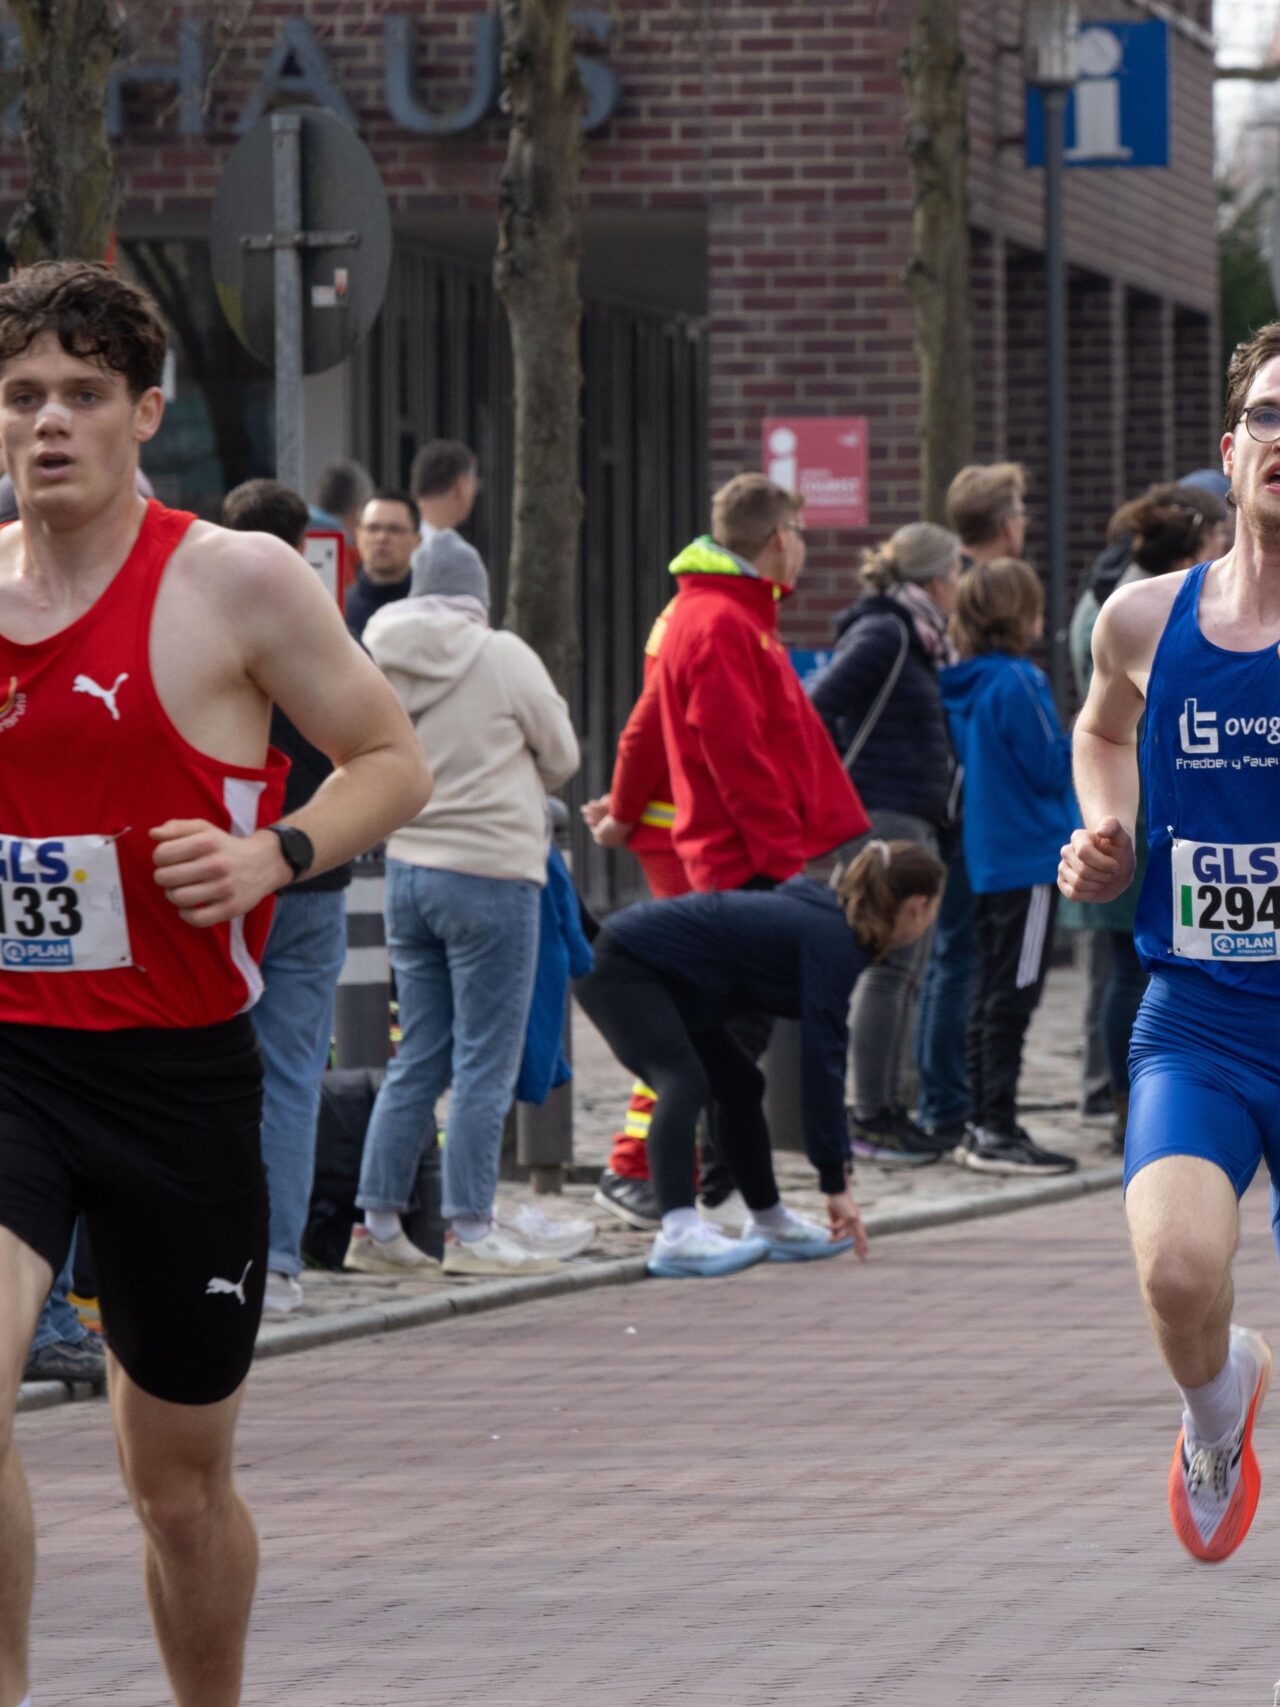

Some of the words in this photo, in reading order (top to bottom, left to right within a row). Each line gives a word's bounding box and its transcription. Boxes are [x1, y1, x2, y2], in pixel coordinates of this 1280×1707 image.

[0, 11, 617, 135] HAUS
[1236, 936, 1274, 949] PLAN
[27, 944, 69, 957] PLAN
